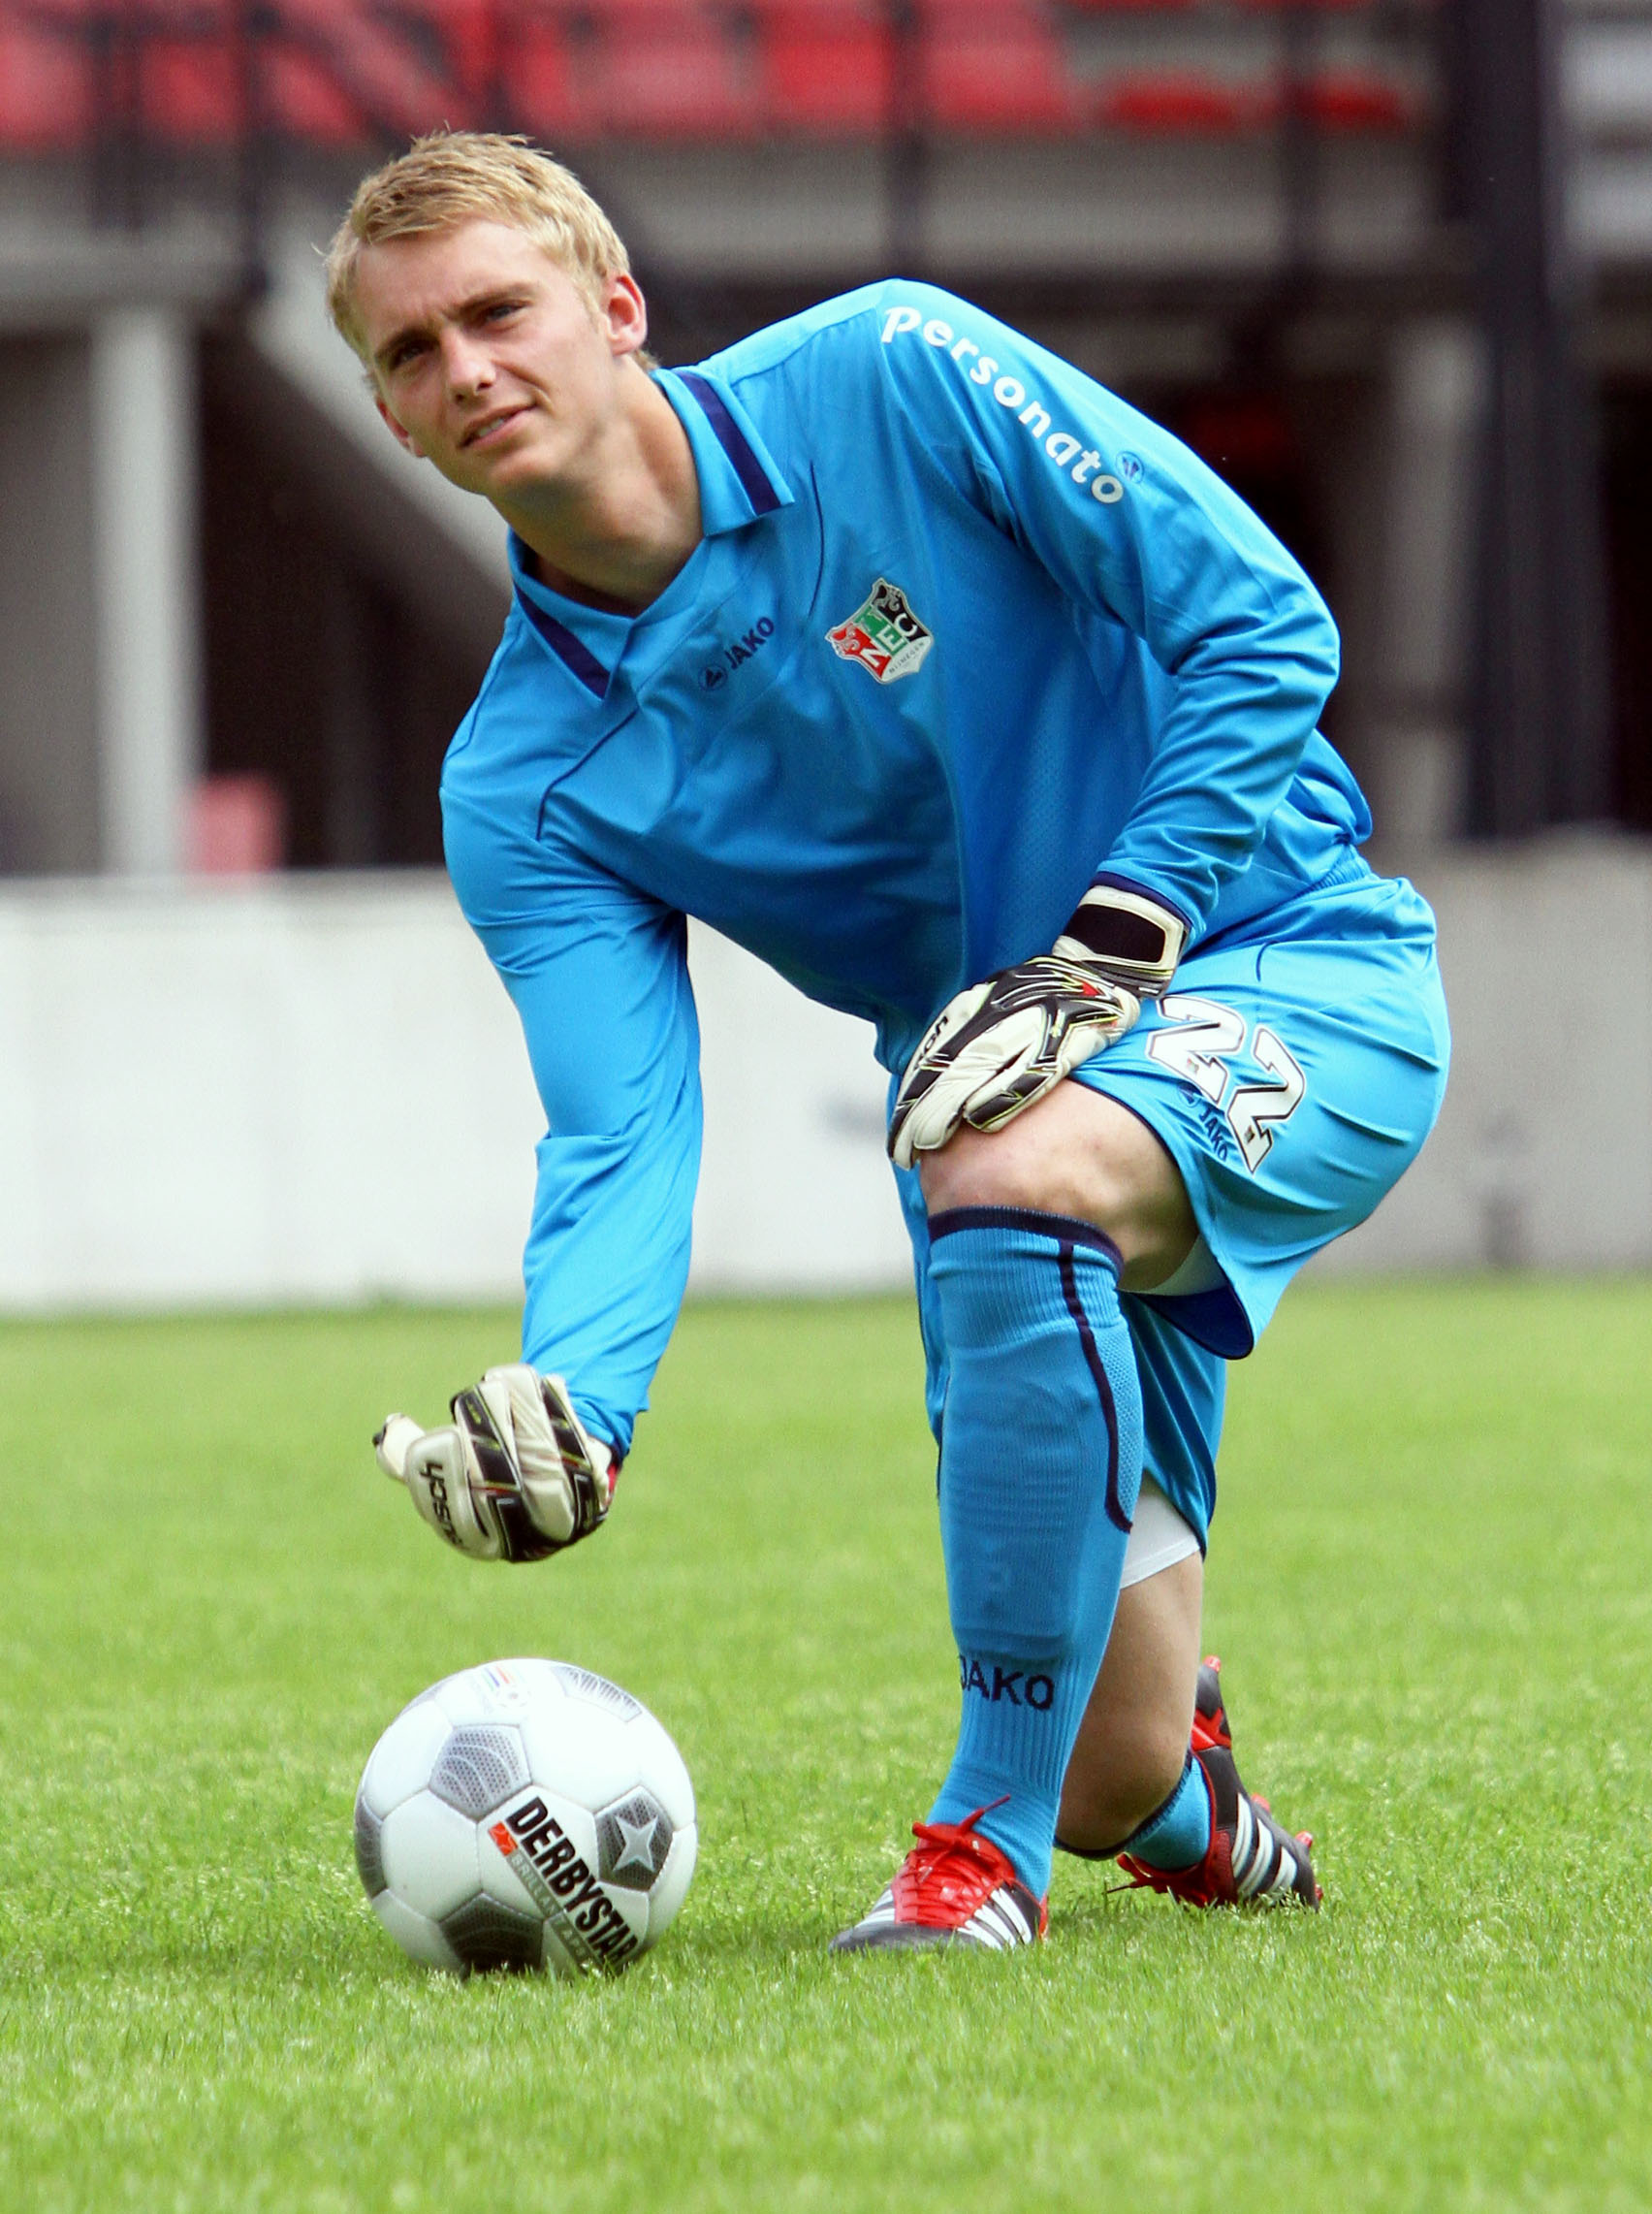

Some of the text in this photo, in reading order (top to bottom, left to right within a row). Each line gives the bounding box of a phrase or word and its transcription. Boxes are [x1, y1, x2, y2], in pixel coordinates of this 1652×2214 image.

[880, 305, 1125, 503] personato
[724, 616, 775, 670] JAKO
[860, 613, 918, 668] NEC
[1146, 996, 1306, 1174] 22
[1198, 1107, 1228, 1162] JAKO
[959, 1652, 1056, 1712] JAKO
[505, 1796, 639, 1970] DERBYSTAR
